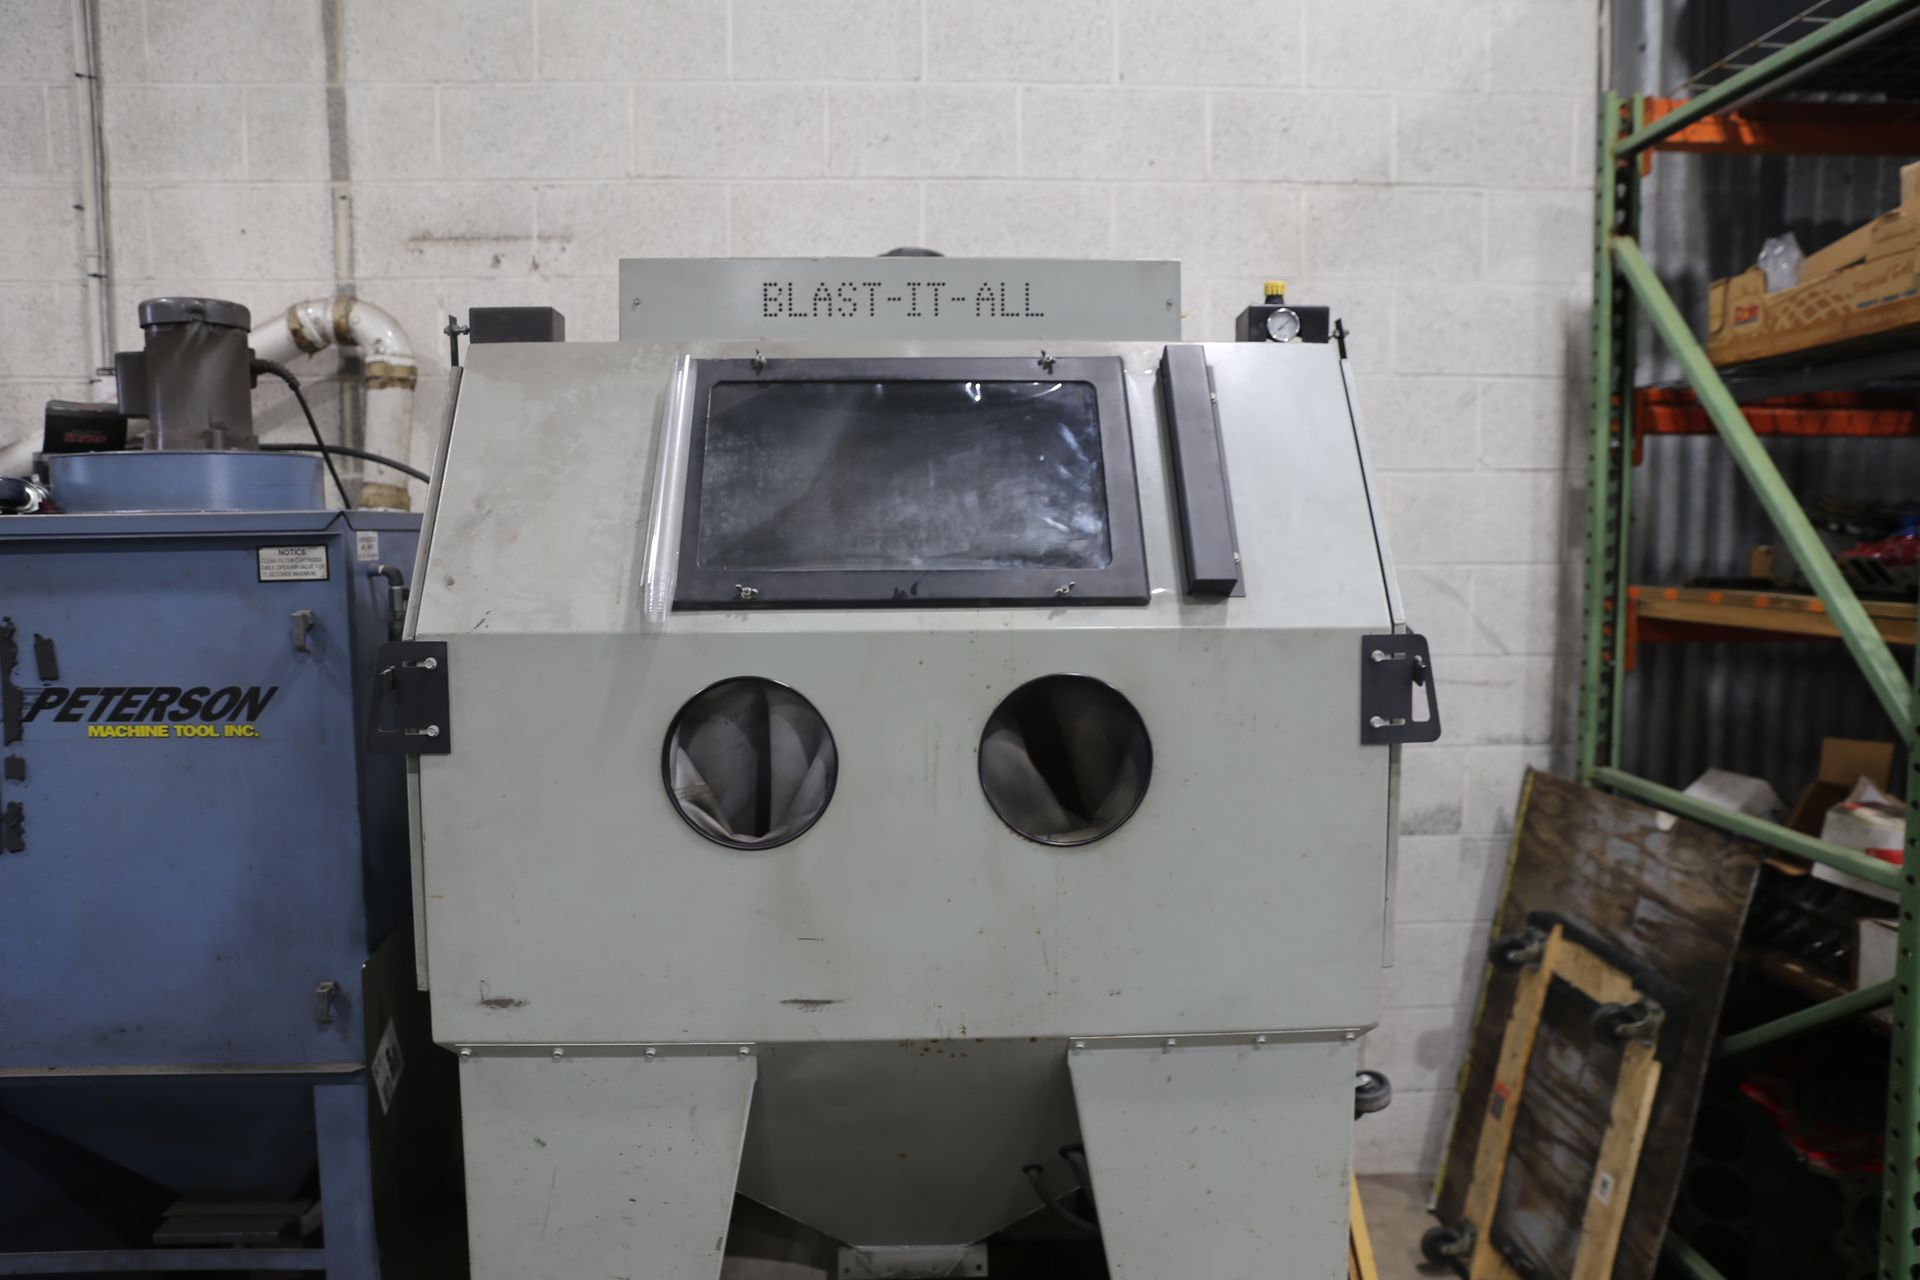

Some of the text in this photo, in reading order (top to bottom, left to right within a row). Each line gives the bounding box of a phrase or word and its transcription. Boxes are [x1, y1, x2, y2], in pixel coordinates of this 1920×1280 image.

[763, 282, 1045, 317] BLAST-IT-ALL
[278, 548, 306, 556] NOTICE
[23, 686, 279, 723] PETERSON
[87, 725, 260, 738] MACHINE TOOL INC.
